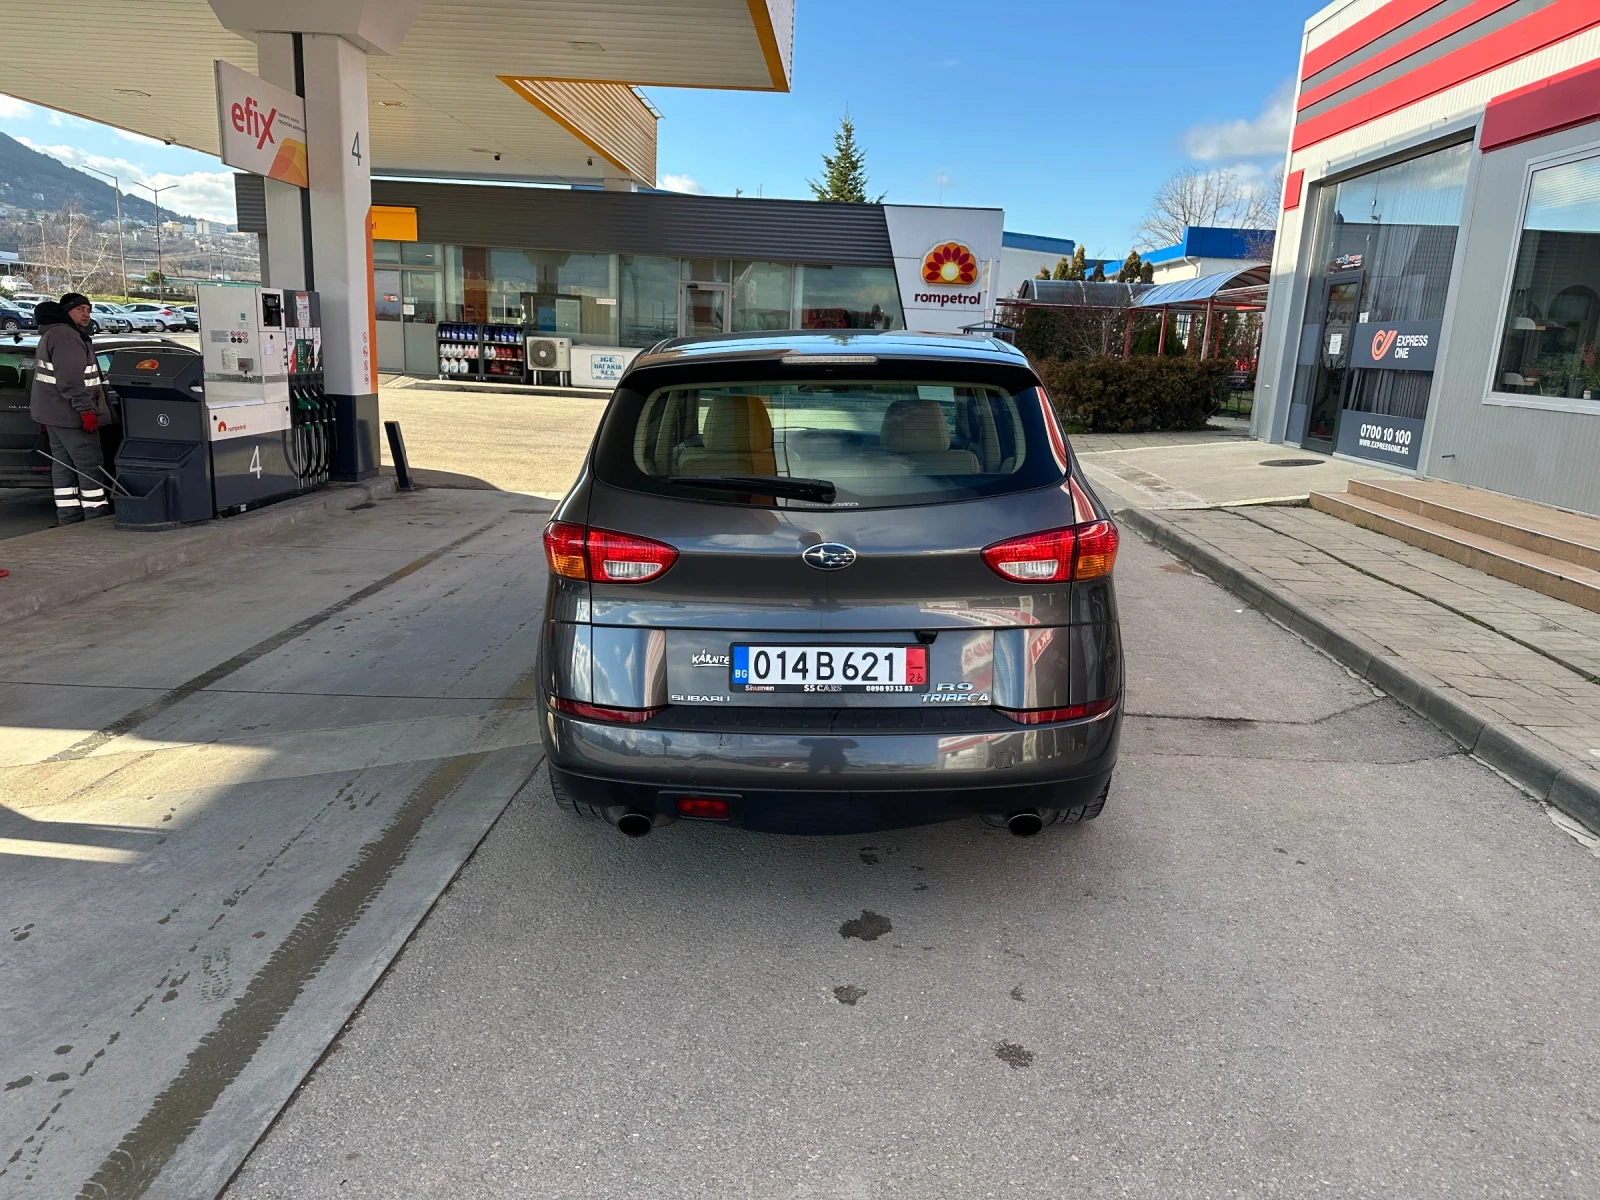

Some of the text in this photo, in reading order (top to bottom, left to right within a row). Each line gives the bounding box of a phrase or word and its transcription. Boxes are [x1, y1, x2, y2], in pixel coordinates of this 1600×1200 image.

[231, 96, 277, 150] efix
[351, 131, 362, 167] 4
[914, 292, 981, 307] rompetrol
[1396, 335, 1428, 347] EXPRESS
[1394, 347, 1409, 359] ONE
[1360, 424, 1411, 445] 0700 10 100
[1358, 438, 1409, 455] WWW.EXPRESSONE.BG
[249, 445, 262, 479] 4
[735, 669, 747, 679] BG
[909, 673, 923, 683] 26
[745, 684, 775, 692] Shumen
[804, 684, 816, 692] SS
[671, 694, 731, 702] SUBARU
[921, 693, 989, 703] TRIBECA
